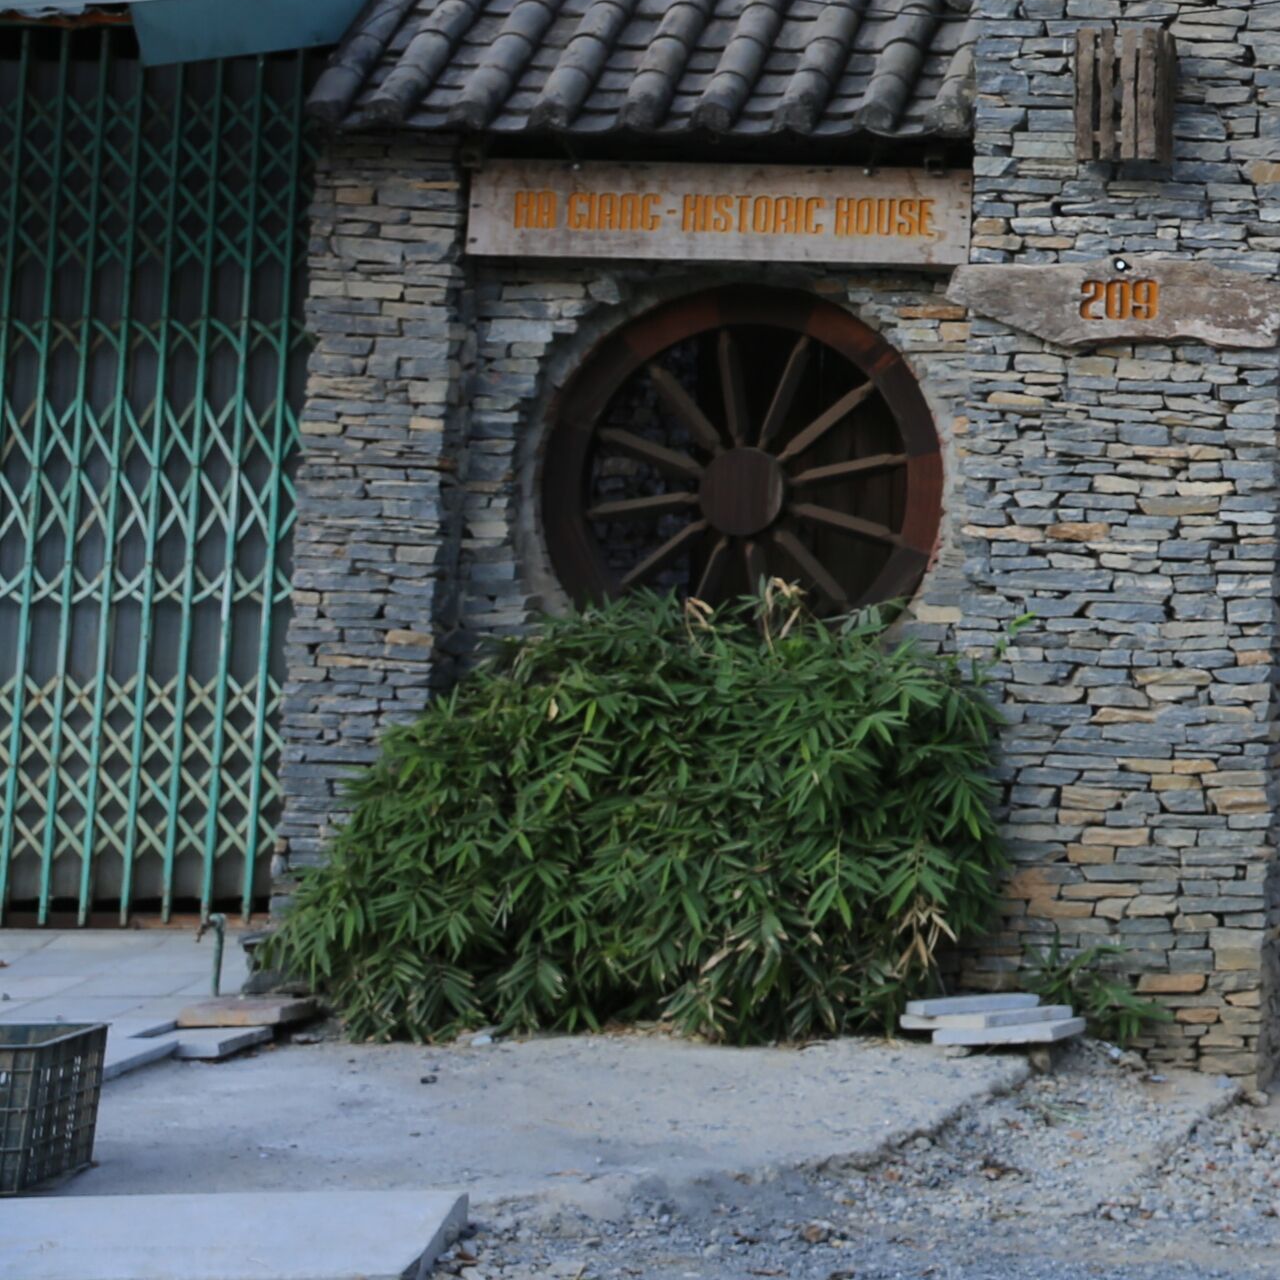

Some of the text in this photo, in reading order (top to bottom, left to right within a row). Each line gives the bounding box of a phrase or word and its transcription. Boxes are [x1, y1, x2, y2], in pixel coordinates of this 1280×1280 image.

[567, 191, 662, 231] GIANG
[682, 193, 827, 235] HISTORIC
[834, 196, 938, 237] HOUSE
[1079, 279, 1160, 320] 209
